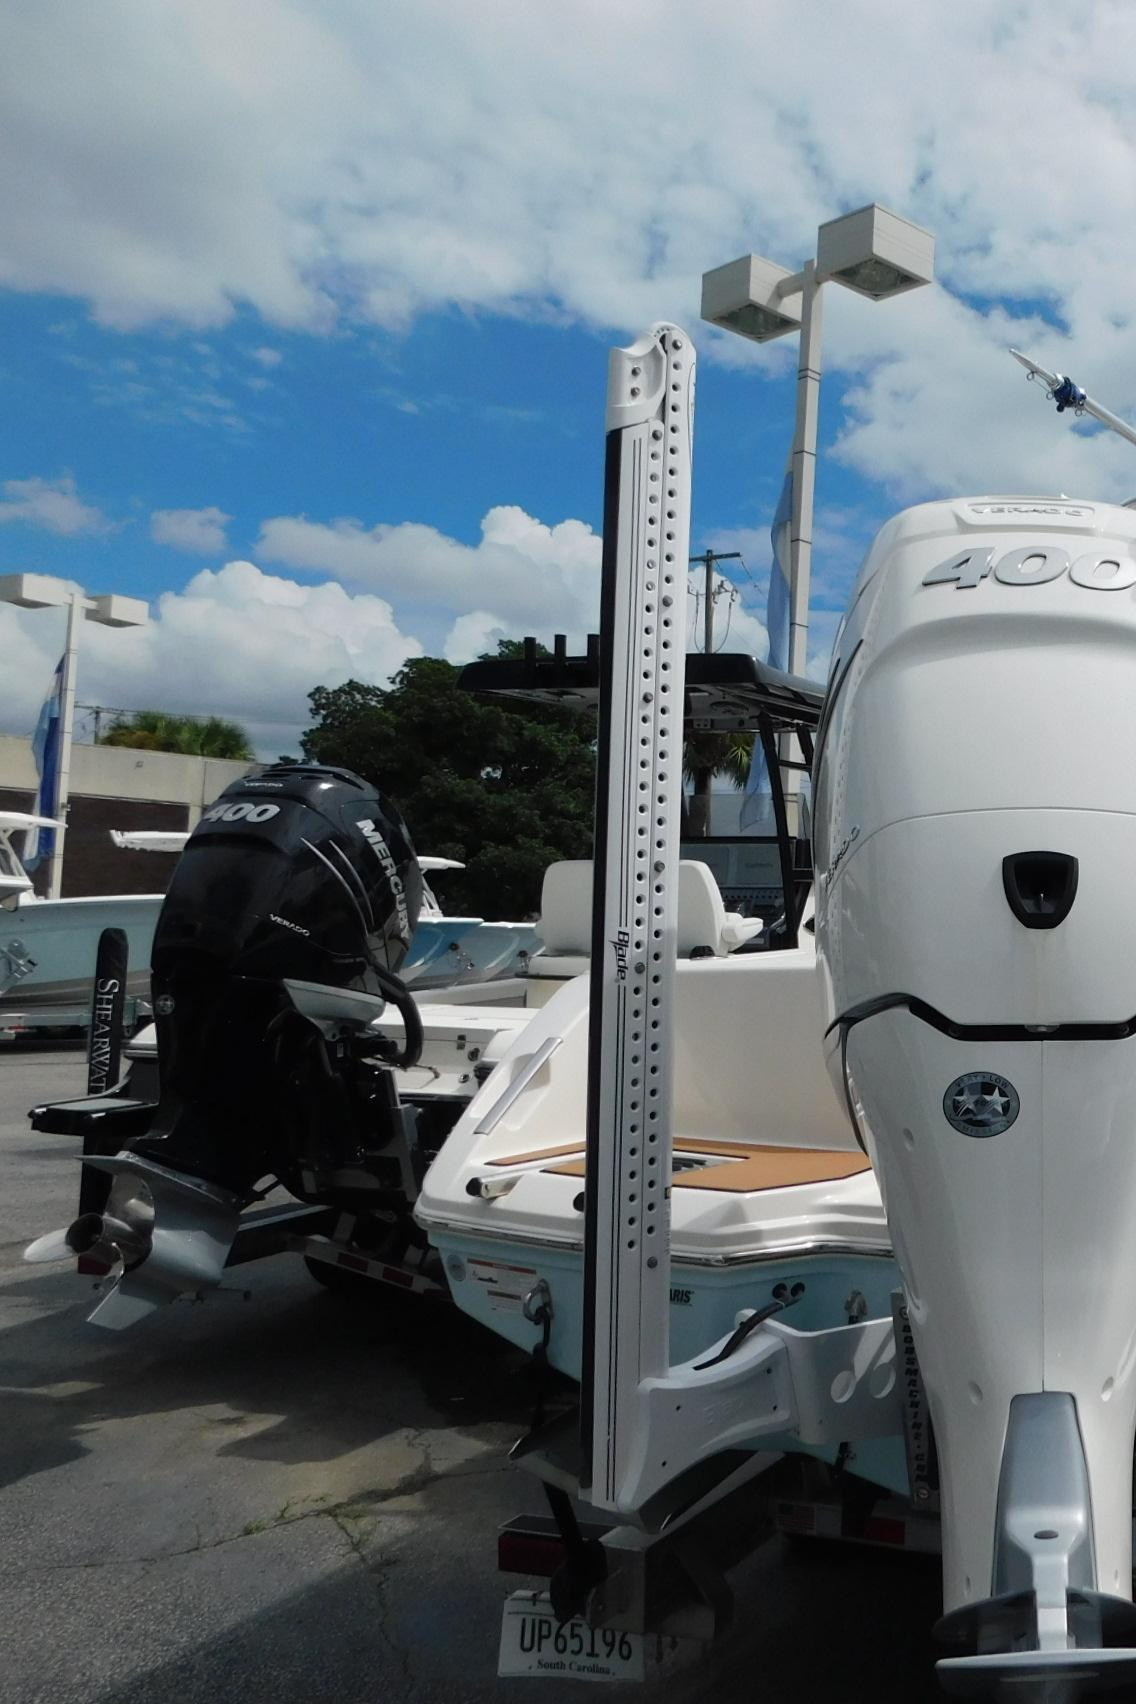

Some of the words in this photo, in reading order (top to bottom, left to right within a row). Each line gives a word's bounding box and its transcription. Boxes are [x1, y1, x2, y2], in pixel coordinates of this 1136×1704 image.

[204, 803, 280, 822] 400
[356, 818, 409, 939] MERCURY
[269, 913, 311, 937] VERADO
[608, 930, 630, 981] Blade
[519, 1617, 632, 1661] UP65196
[537, 1658, 566, 1671] South
[568, 1662, 611, 1676] Carolina
